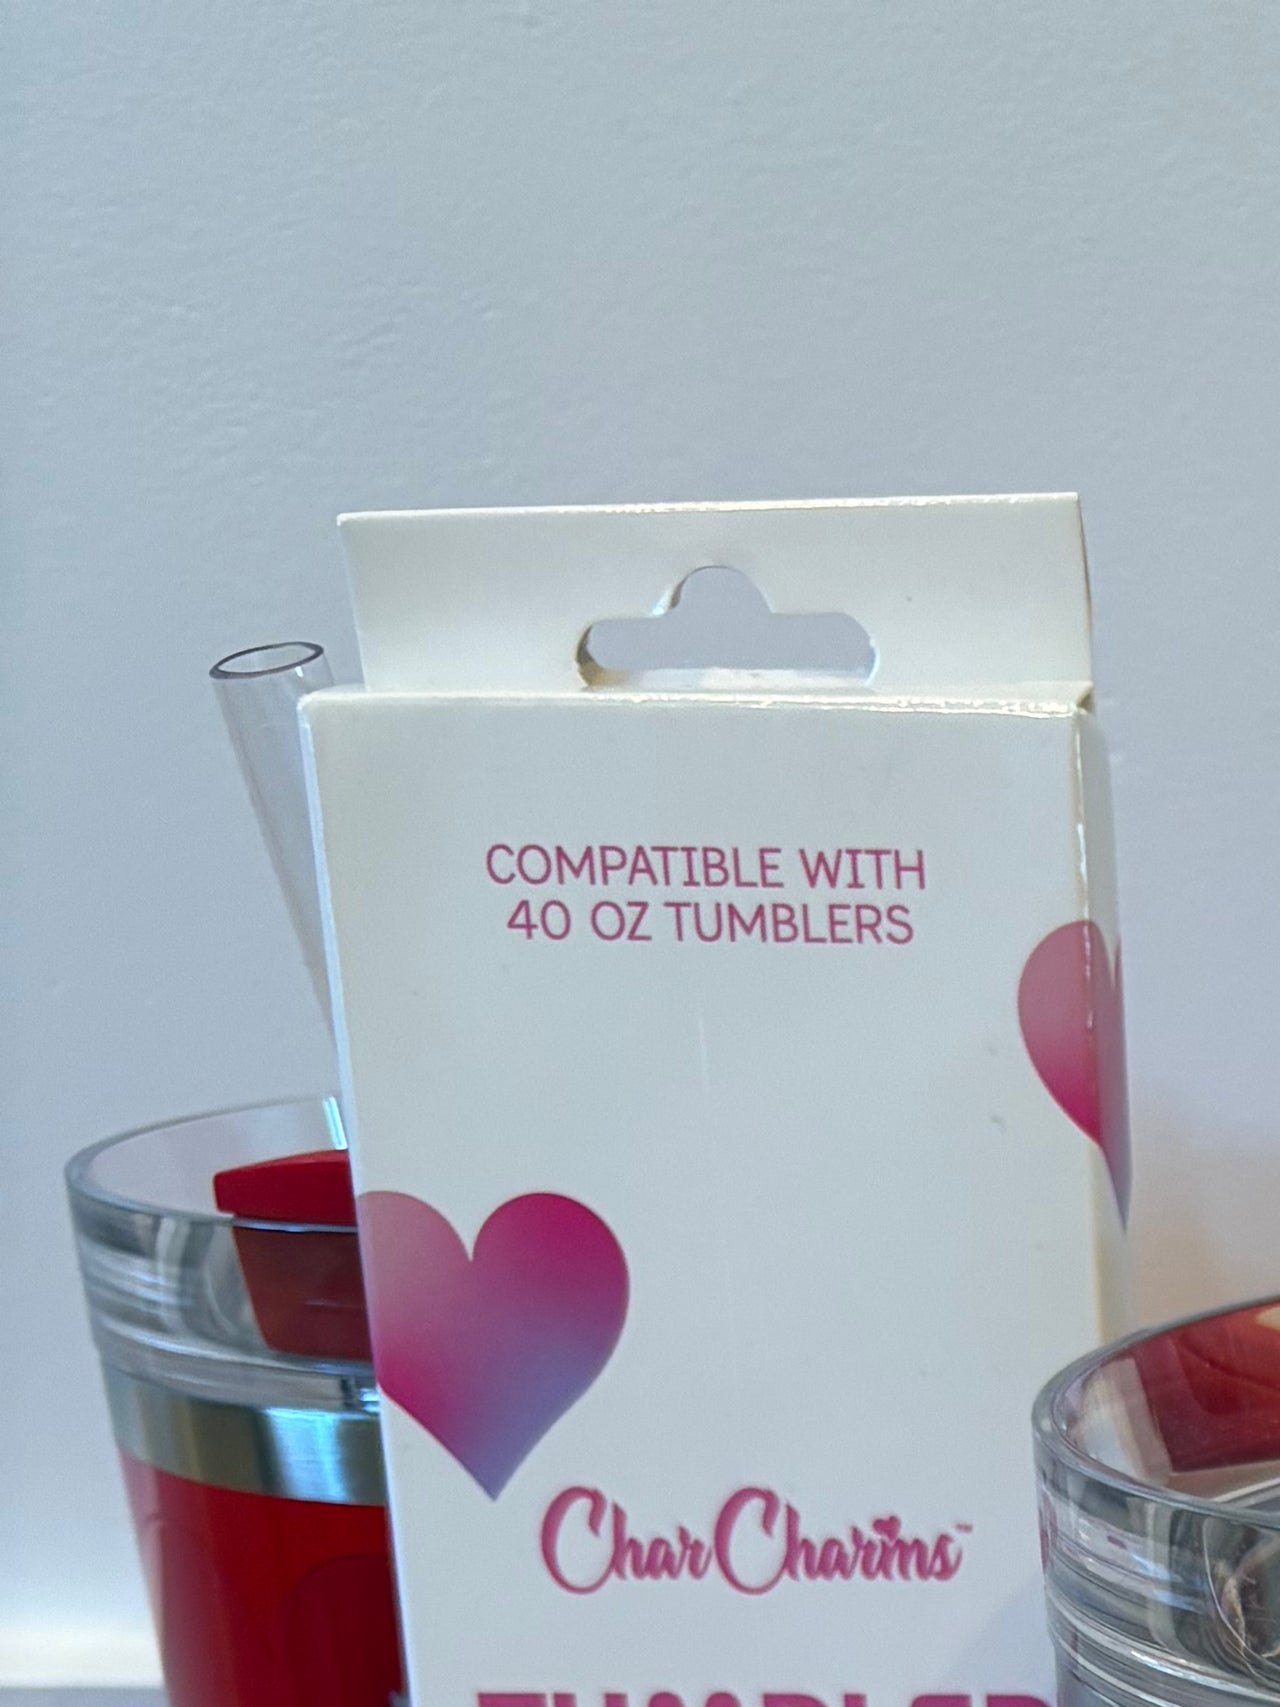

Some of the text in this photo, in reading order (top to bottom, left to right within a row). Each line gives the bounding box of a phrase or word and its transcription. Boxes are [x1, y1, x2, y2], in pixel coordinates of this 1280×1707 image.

[486, 844, 926, 890] COMPATIBLE WITH
[507, 899, 915, 945] 40 OZ TUMBLERS
